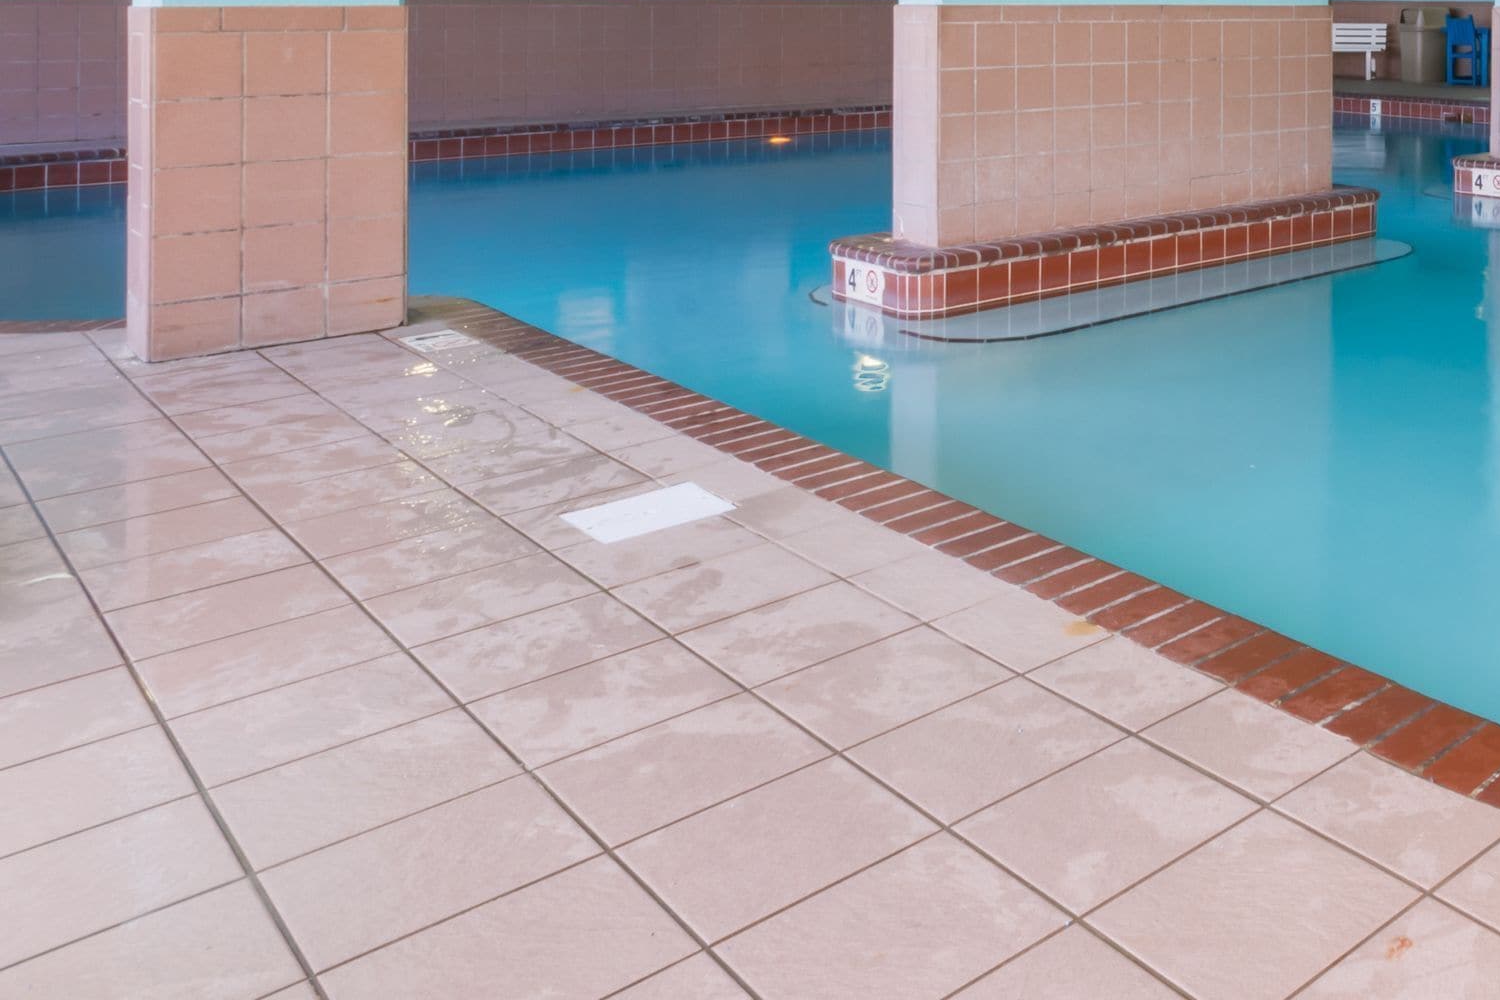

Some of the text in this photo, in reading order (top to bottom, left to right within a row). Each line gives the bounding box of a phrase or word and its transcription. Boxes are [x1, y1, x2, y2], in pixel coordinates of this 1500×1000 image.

[1372, 102, 1376, 112] 5
[1474, 174, 1482, 190] 4
[848, 268, 856, 292] 4
